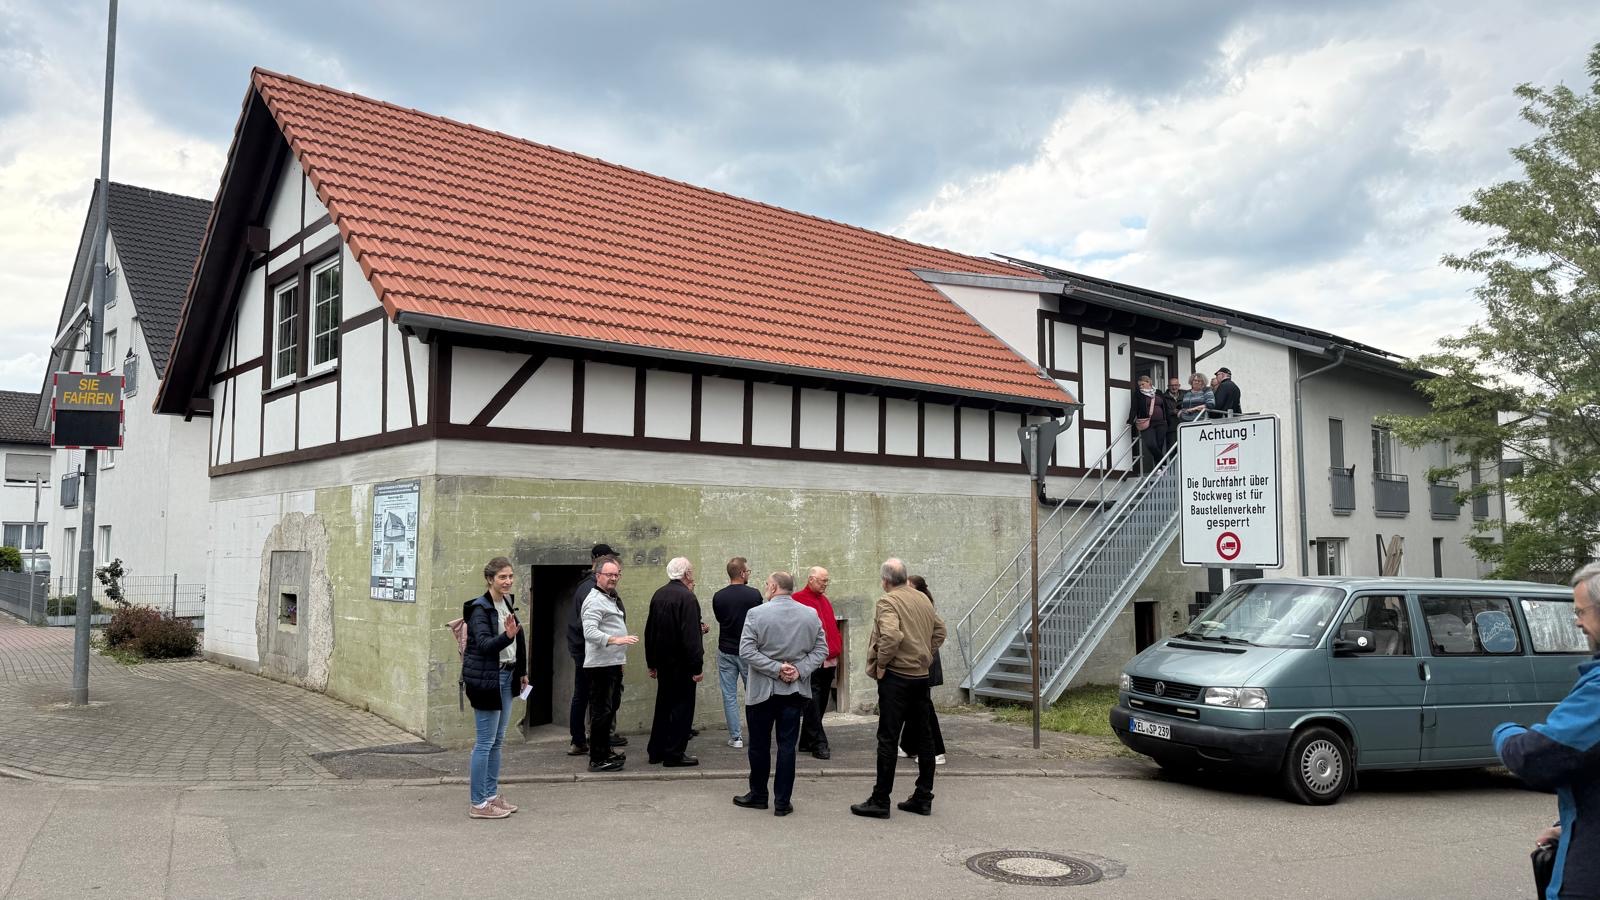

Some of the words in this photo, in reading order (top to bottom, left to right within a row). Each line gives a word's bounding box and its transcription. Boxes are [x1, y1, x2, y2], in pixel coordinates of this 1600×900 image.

[79, 379, 99, 390] SIE
[63, 392, 113, 405] FAHREN
[1199, 427, 1247, 441] Achtung
[1252, 424, 1256, 436] !
[1187, 478, 1199, 489] Die
[1202, 477, 1246, 488] Durchfahrt
[1249, 475, 1269, 486] über
[1192, 491, 1232, 502] Stockweg
[1235, 490, 1247, 500] ist
[1250, 489, 1263, 500] für
[1190, 505, 1266, 515] Baustellenverkehr
[1206, 518, 1250, 529] gesperrt
[1149, 723, 1157, 735] SP
[1158, 725, 1169, 738] 239
